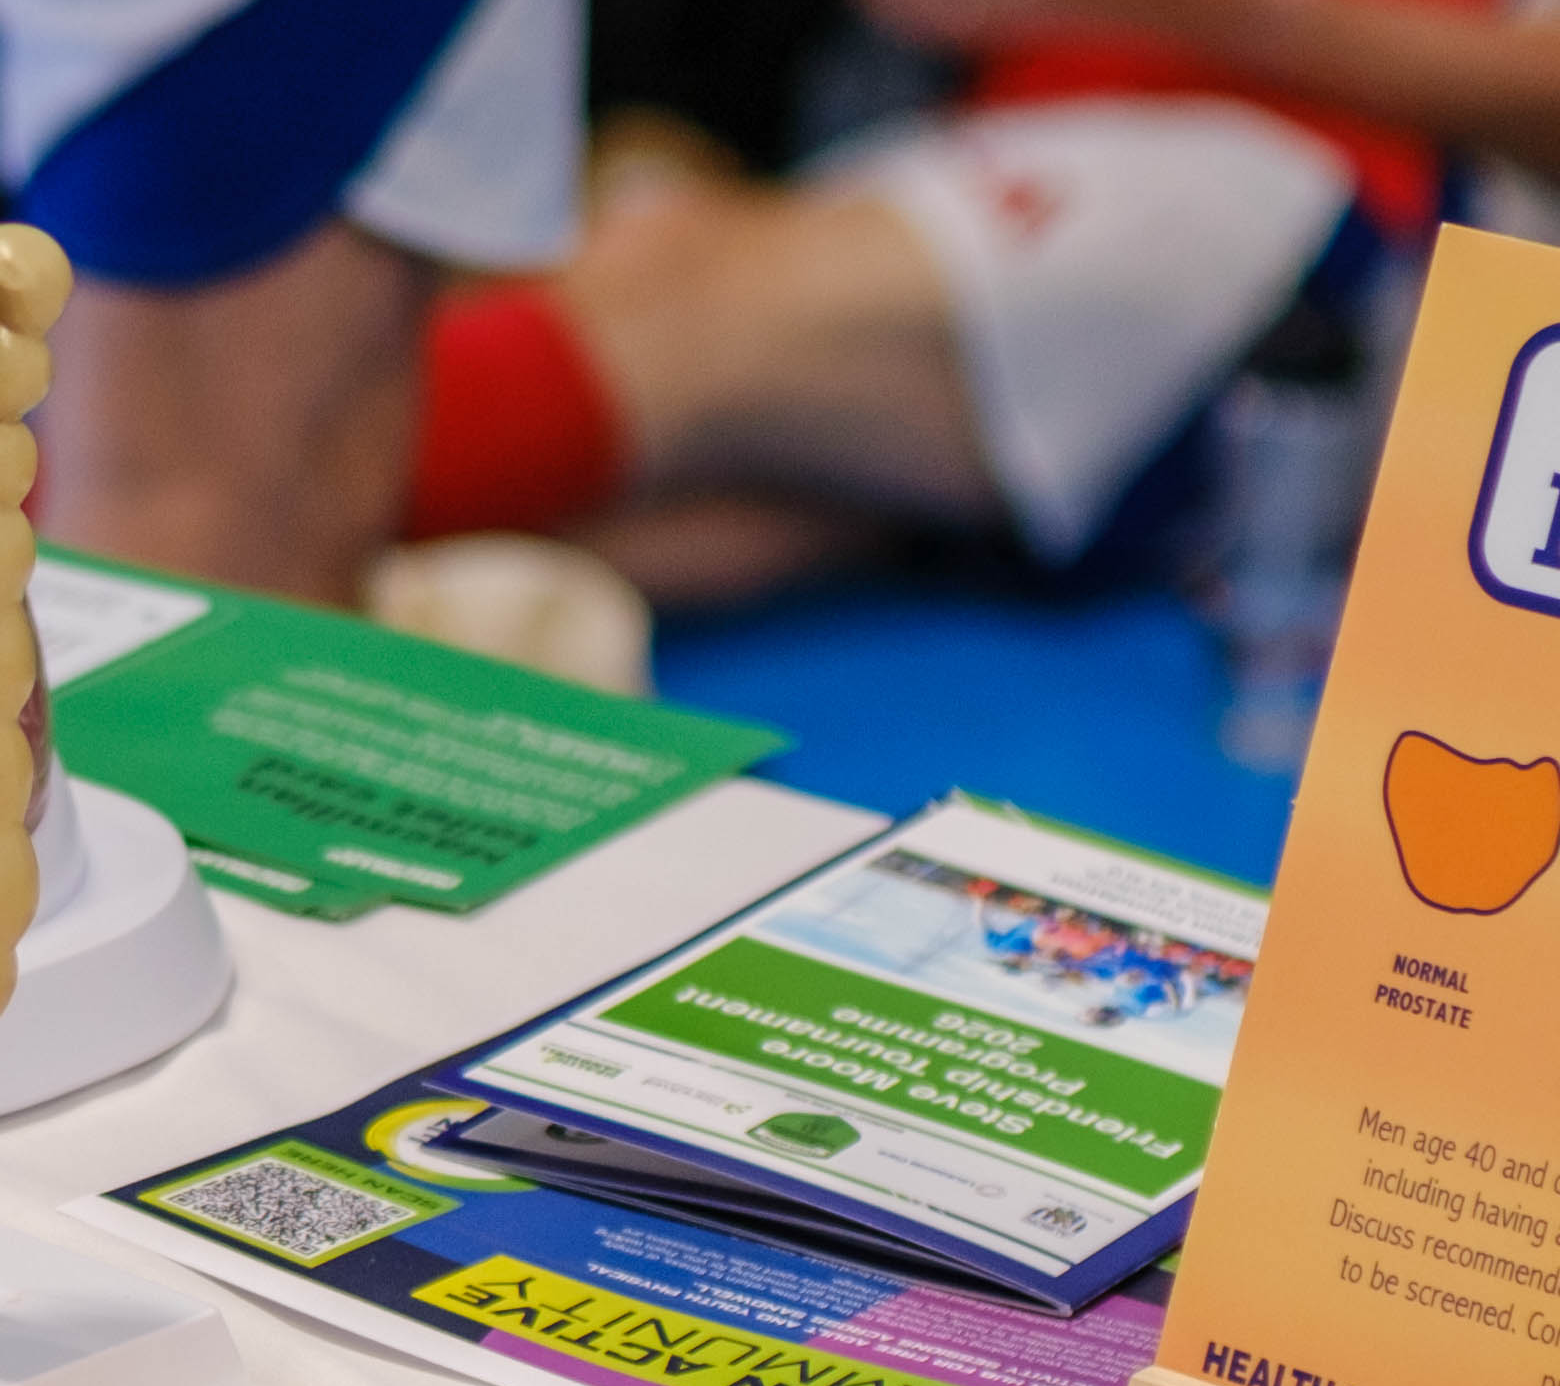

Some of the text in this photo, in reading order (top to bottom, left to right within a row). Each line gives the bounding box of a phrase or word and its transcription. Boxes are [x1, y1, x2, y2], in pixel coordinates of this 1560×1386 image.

[1374, 983, 1473, 1030] PROSTATE
[1392, 953, 1469, 994] NORMAL
[675, 985, 1184, 1159] Friendship Tournament
[761, 1039, 1034, 1135] Steve Moore
[831, 1007, 1087, 1097] Programme
[1357, 1105, 1407, 1147] Men
[1412, 1130, 1457, 1166] age
[1463, 1140, 1497, 1173] 40
[1501, 1158, 1549, 1189] and
[1329, 1197, 1416, 1251] Discuss
[1362, 1158, 1466, 1223] including
[1471, 1191, 1549, 1249] having
[446, 1284, 715, 1377] ACTIVE
[1340, 1255, 1363, 1284] to
[1369, 1260, 1400, 1296] be
[1404, 1280, 1516, 1334] screened.
